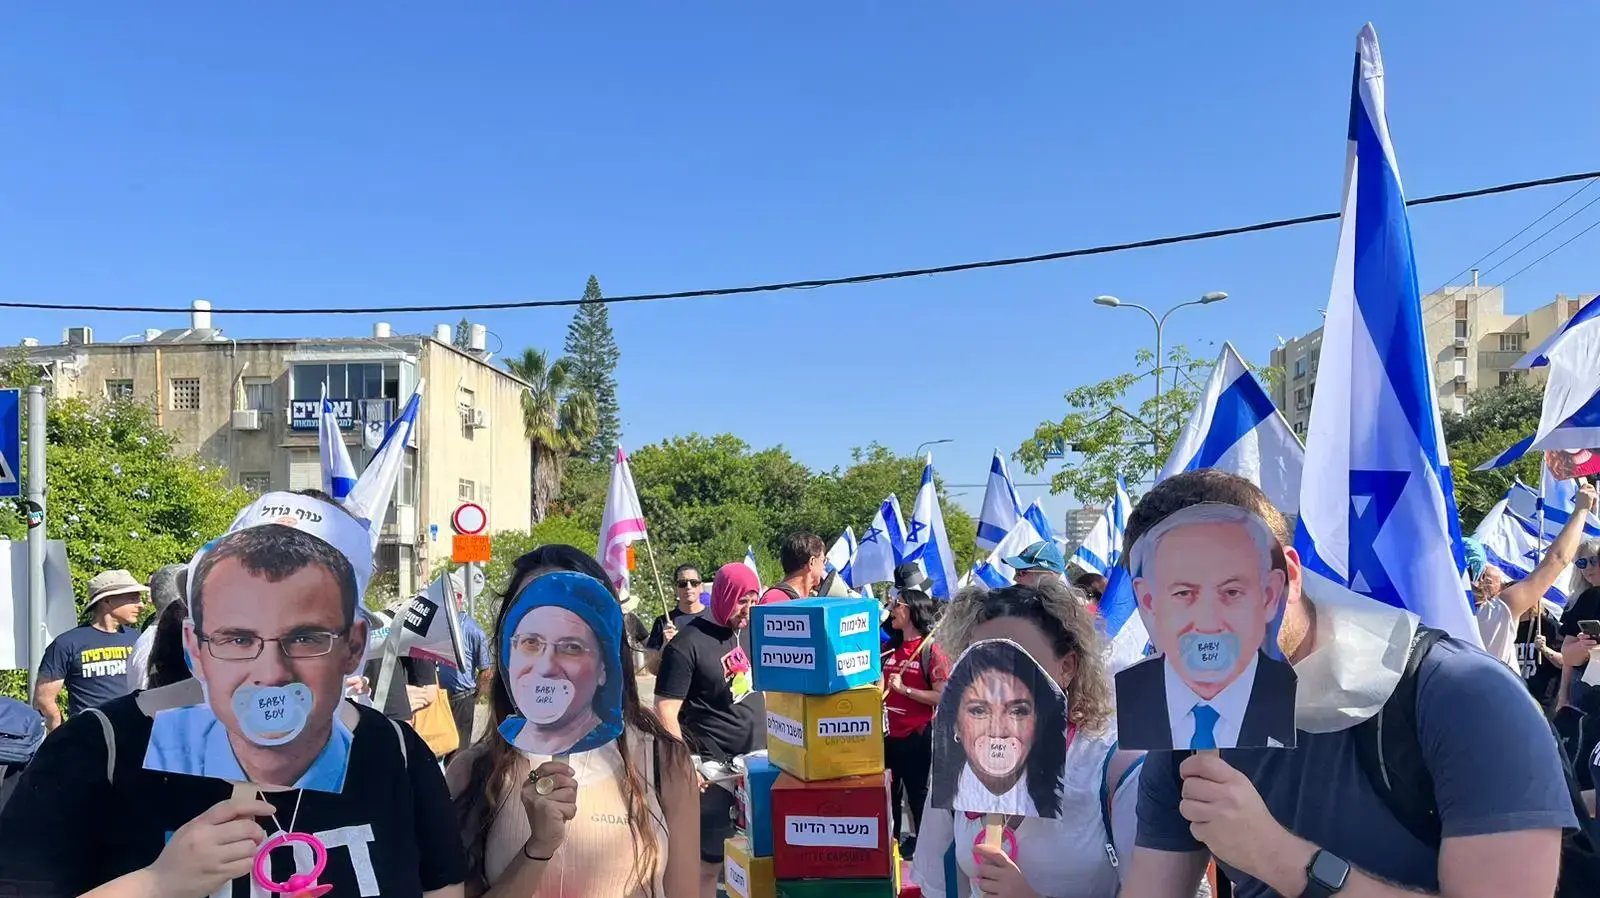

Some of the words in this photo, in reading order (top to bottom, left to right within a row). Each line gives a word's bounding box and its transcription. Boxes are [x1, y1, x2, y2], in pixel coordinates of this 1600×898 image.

[293, 401, 352, 418] נאנים
[767, 620, 804, 631] הפיכה
[841, 616, 867, 632] אלימות
[1197, 642, 1219, 651] BABY
[762, 652, 813, 664] משטרית
[857, 654, 868, 666] נגד
[1202, 653, 1218, 661] BOY
[837, 657, 855, 670] נשים
[535, 685, 555, 694] BABY
[258, 695, 285, 709] BABY
[536, 695, 553, 704] GIRL
[264, 708, 284, 720] BOY
[820, 721, 870, 734] תחבורה
[991, 751, 1004, 759] GIRL
[791, 822, 825, 834] הדיור
[830, 823, 869, 834] משבר
